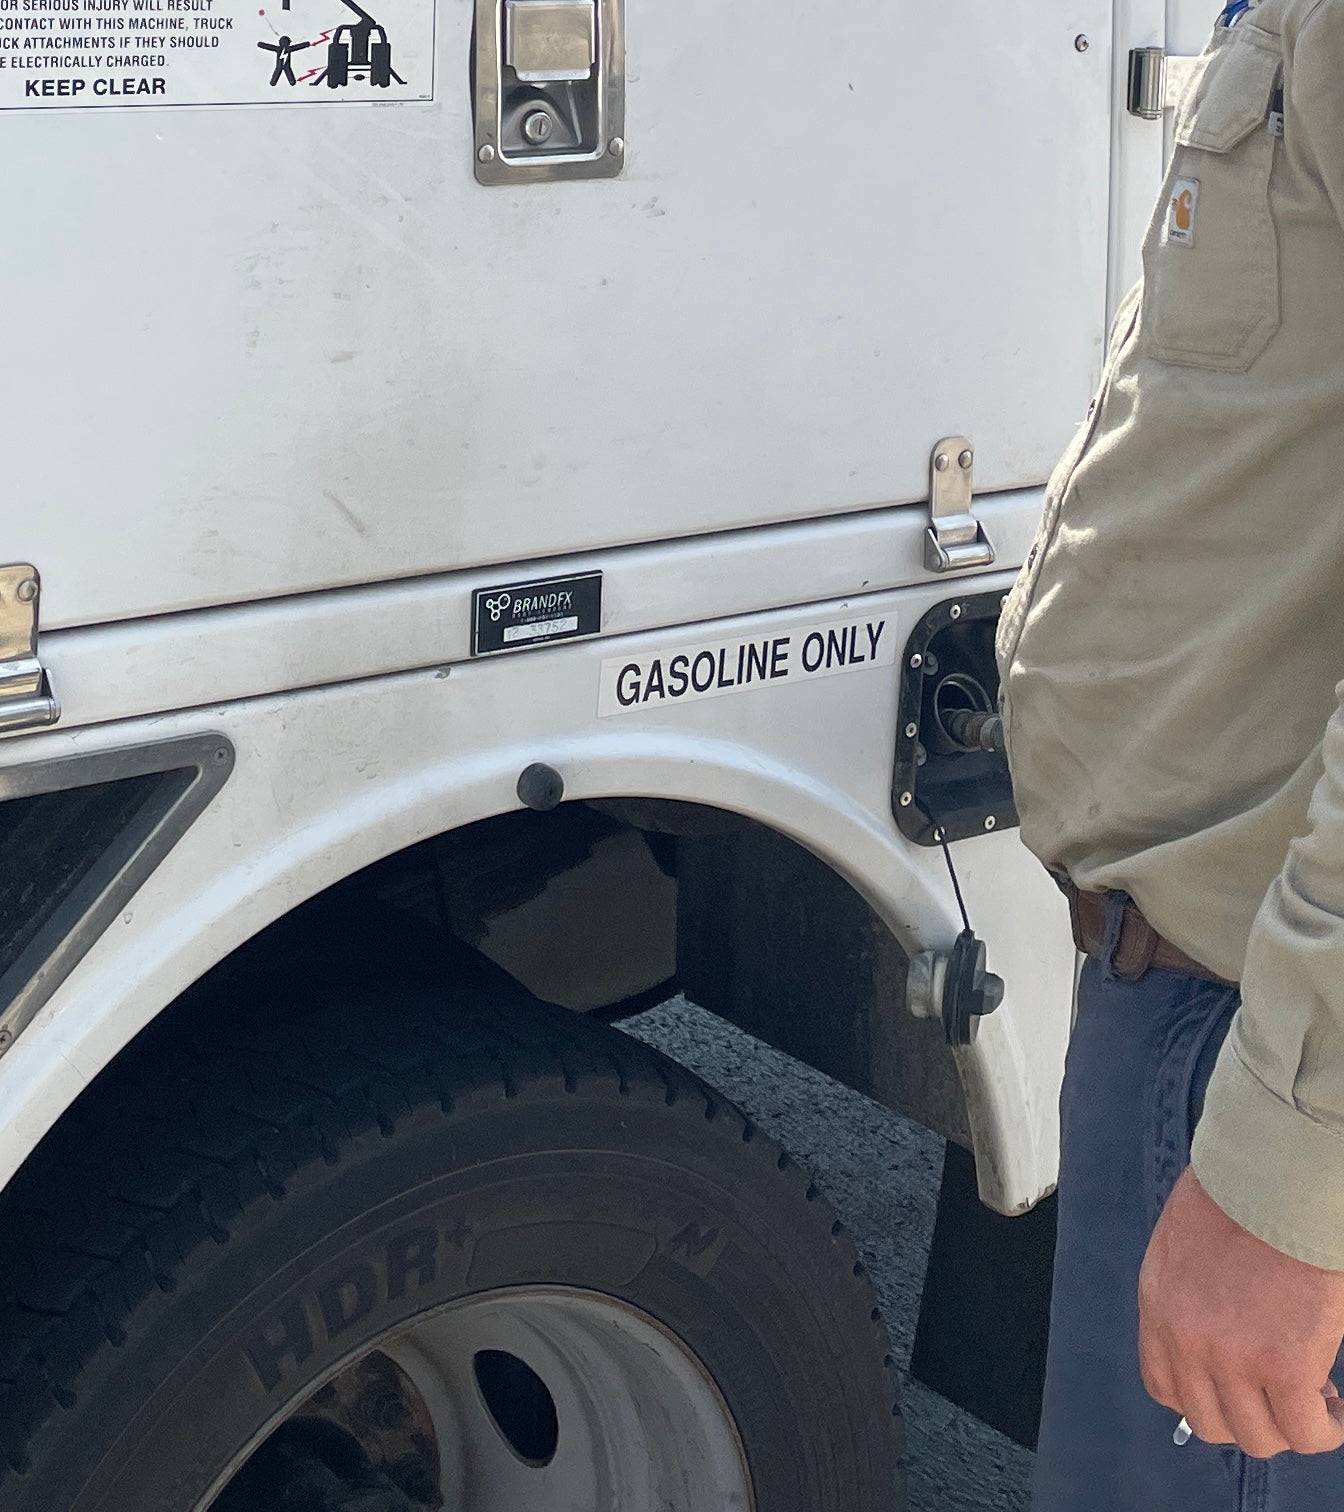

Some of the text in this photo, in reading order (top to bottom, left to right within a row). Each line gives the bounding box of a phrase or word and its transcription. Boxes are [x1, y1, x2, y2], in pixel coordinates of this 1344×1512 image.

[0, 0, 17, 11] OR
[22, 0, 78, 11] SERIOUS
[84, 0, 129, 11] INJURY
[133, 0, 163, 11] WILL
[167, 0, 213, 11] RESULT
[58, 18, 91, 30] WITH
[96, 18, 124, 30] THIS
[129, 18, 189, 31] MACHINE,
[194, 18, 233, 29] TRUCK
[24, 37, 116, 49] ATTACHMENTS
[120, 37, 131, 48] IF
[135, 37, 165, 48] THEY
[170, 36, 219, 48] SHOULD
[11, 56, 102, 68] ELECTRICALLY
[25, 78, 165, 96] KEEP CLEAR
[512, 591, 573, 614] BRANDFX
[616, 621, 885, 707] GASOLINE ONLY
